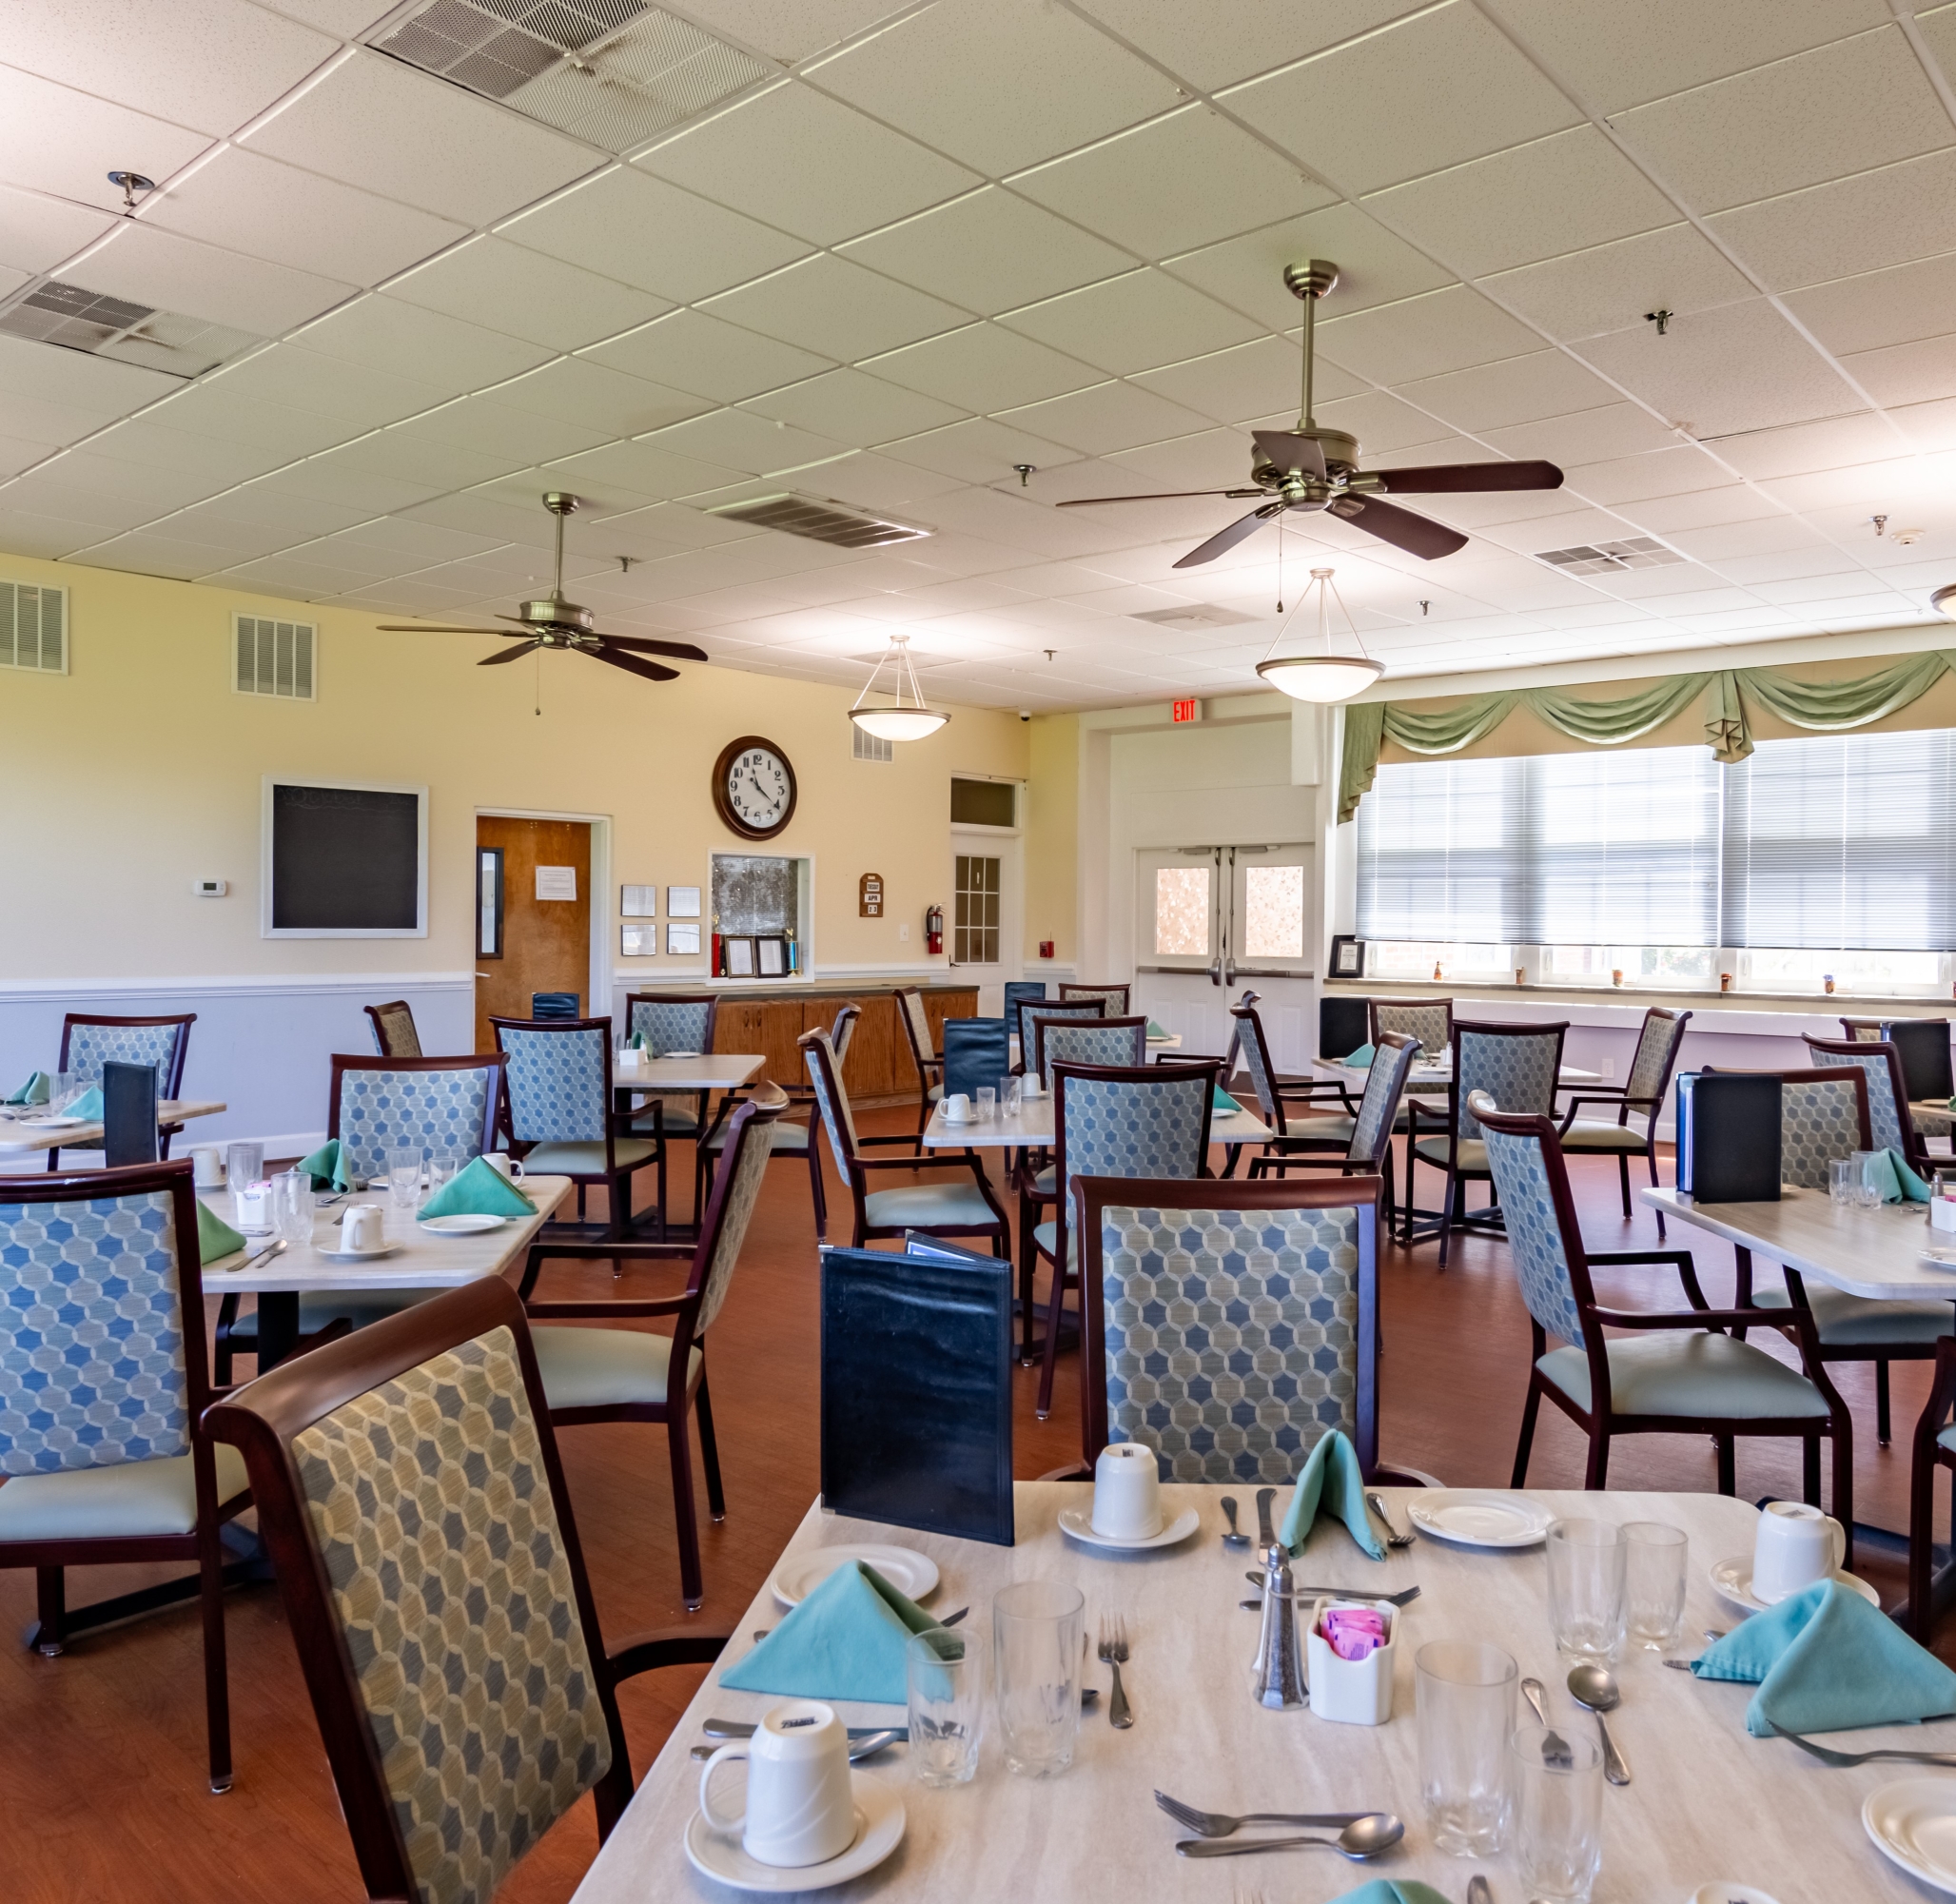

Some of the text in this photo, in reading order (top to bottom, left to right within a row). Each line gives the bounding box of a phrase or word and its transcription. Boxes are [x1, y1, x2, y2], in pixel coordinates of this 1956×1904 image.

[1173, 699, 1196, 722] EXIT
[743, 756, 750, 768] 11
[753, 755, 762, 765] 12
[767, 759, 772, 771] 1
[734, 767, 743, 778] 10
[774, 770, 781, 781] 2
[730, 780, 738, 792] 9
[777, 785, 786, 796] 3
[734, 795, 742, 807] 8
[773, 798, 781, 811] 4
[742, 806, 750, 816] 7
[753, 811, 761, 823] 6
[766, 809, 773, 820] 5
